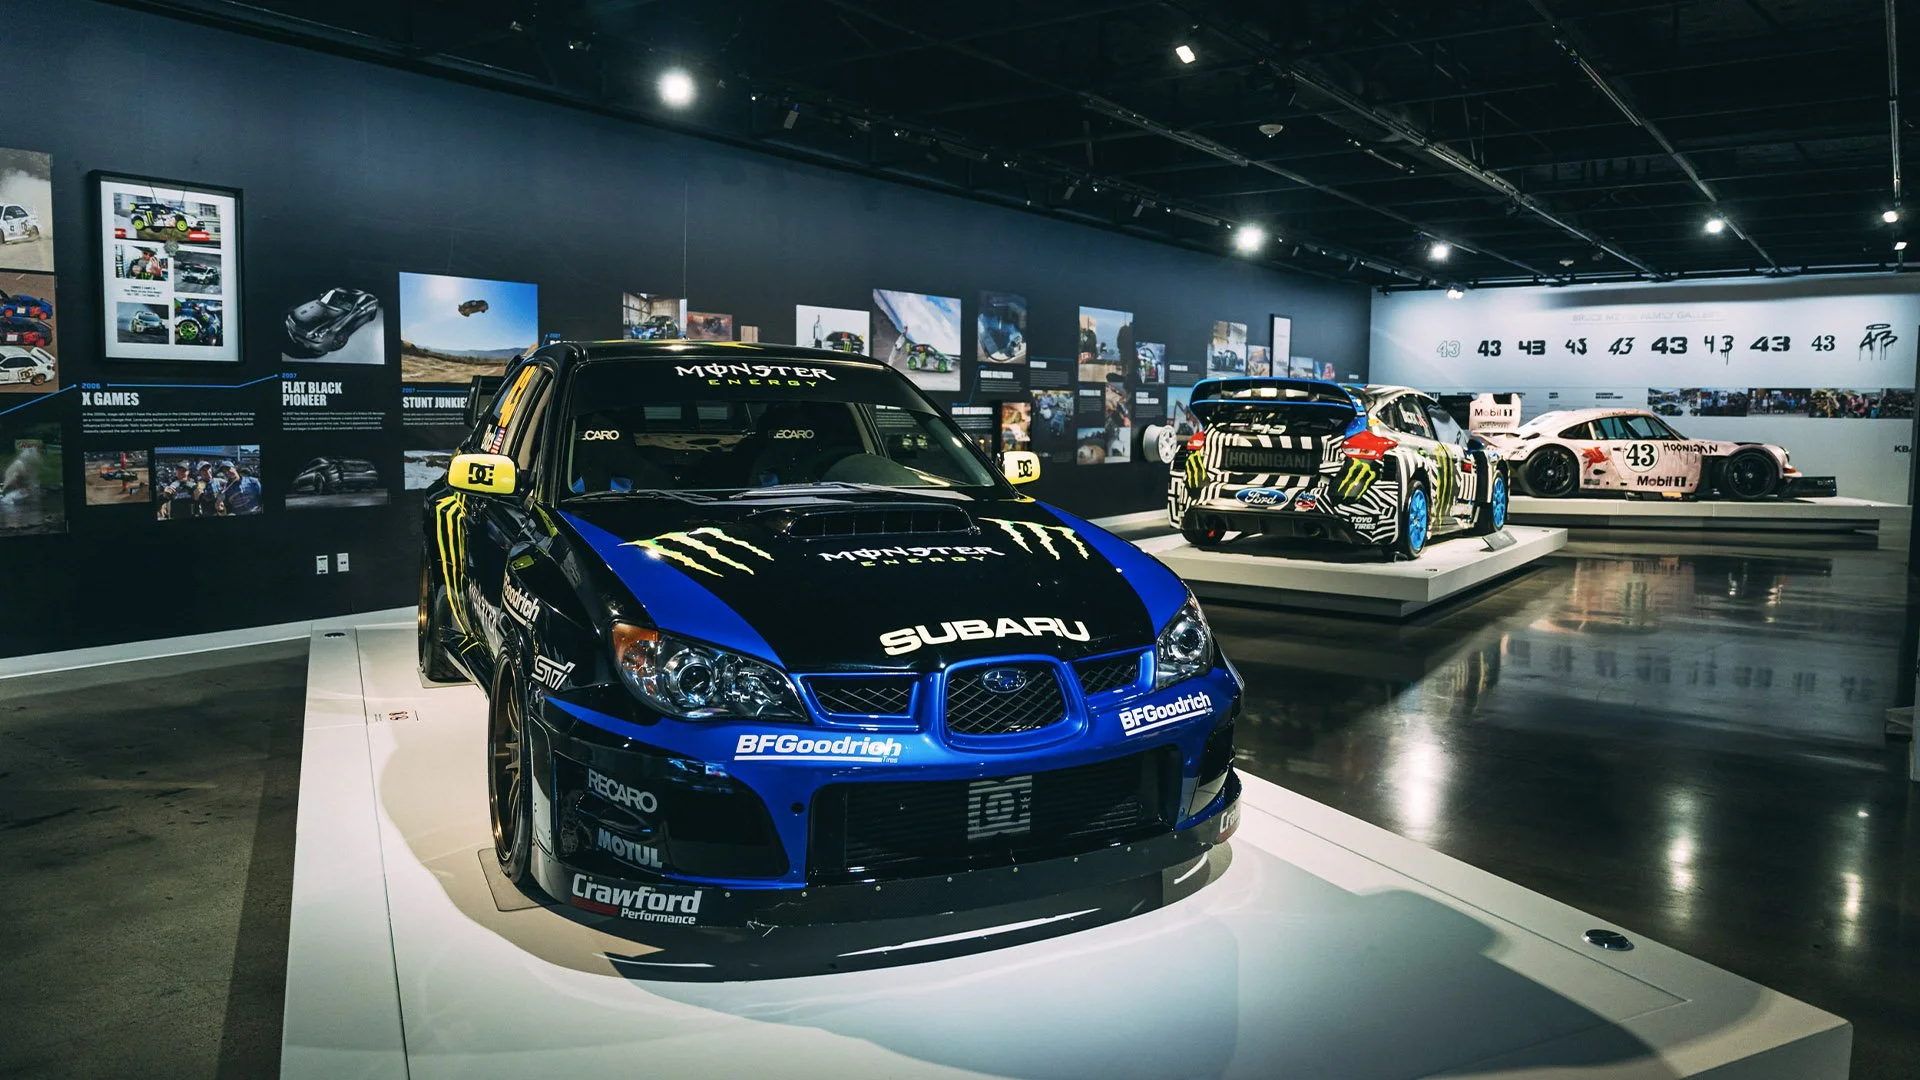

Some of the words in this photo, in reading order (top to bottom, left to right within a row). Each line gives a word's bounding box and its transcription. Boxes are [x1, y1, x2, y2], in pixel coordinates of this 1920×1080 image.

[1436, 340, 1461, 358] 43
[1477, 340, 1502, 357] 43
[1518, 340, 1546, 356] 43
[1565, 337, 1588, 356] 43
[1608, 337, 1636, 356] 43
[1651, 336, 1688, 354] 43
[1704, 335, 1734, 358] 43
[1750, 336, 1791, 352] 43
[1811, 335, 1836, 351] 43
[673, 362, 836, 381] MONSTER
[282, 381, 307, 394] FLAT
[308, 382, 343, 394] BLACK
[708, 379, 818, 388] ENERGY
[82, 392, 92, 406] X
[94, 392, 140, 407] GAMES
[282, 394, 327, 406] PIONEER
[402, 396, 434, 409] STUNT
[1474, 409, 1502, 417] Mobil
[1625, 443, 1656, 466] 43
[1894, 445, 1912, 453] KB
[468, 462, 495, 486] DC
[1637, 475, 1673, 487] Mobil
[1674, 476, 1687, 487] 1
[1245, 489, 1277, 505] Ford
[818, 546, 1006, 562] MONSTER
[860, 556, 985, 567] ENERGY
[879, 617, 1091, 656] SUBARU
[1119, 691, 1212, 730] BFGoodrich
[735, 734, 902, 756] BFGoodrich
[588, 768, 658, 813] RECARO
[598, 827, 663, 869] MOTUL
[571, 873, 703, 914] Crawford
[620, 907, 696, 926] Performance
